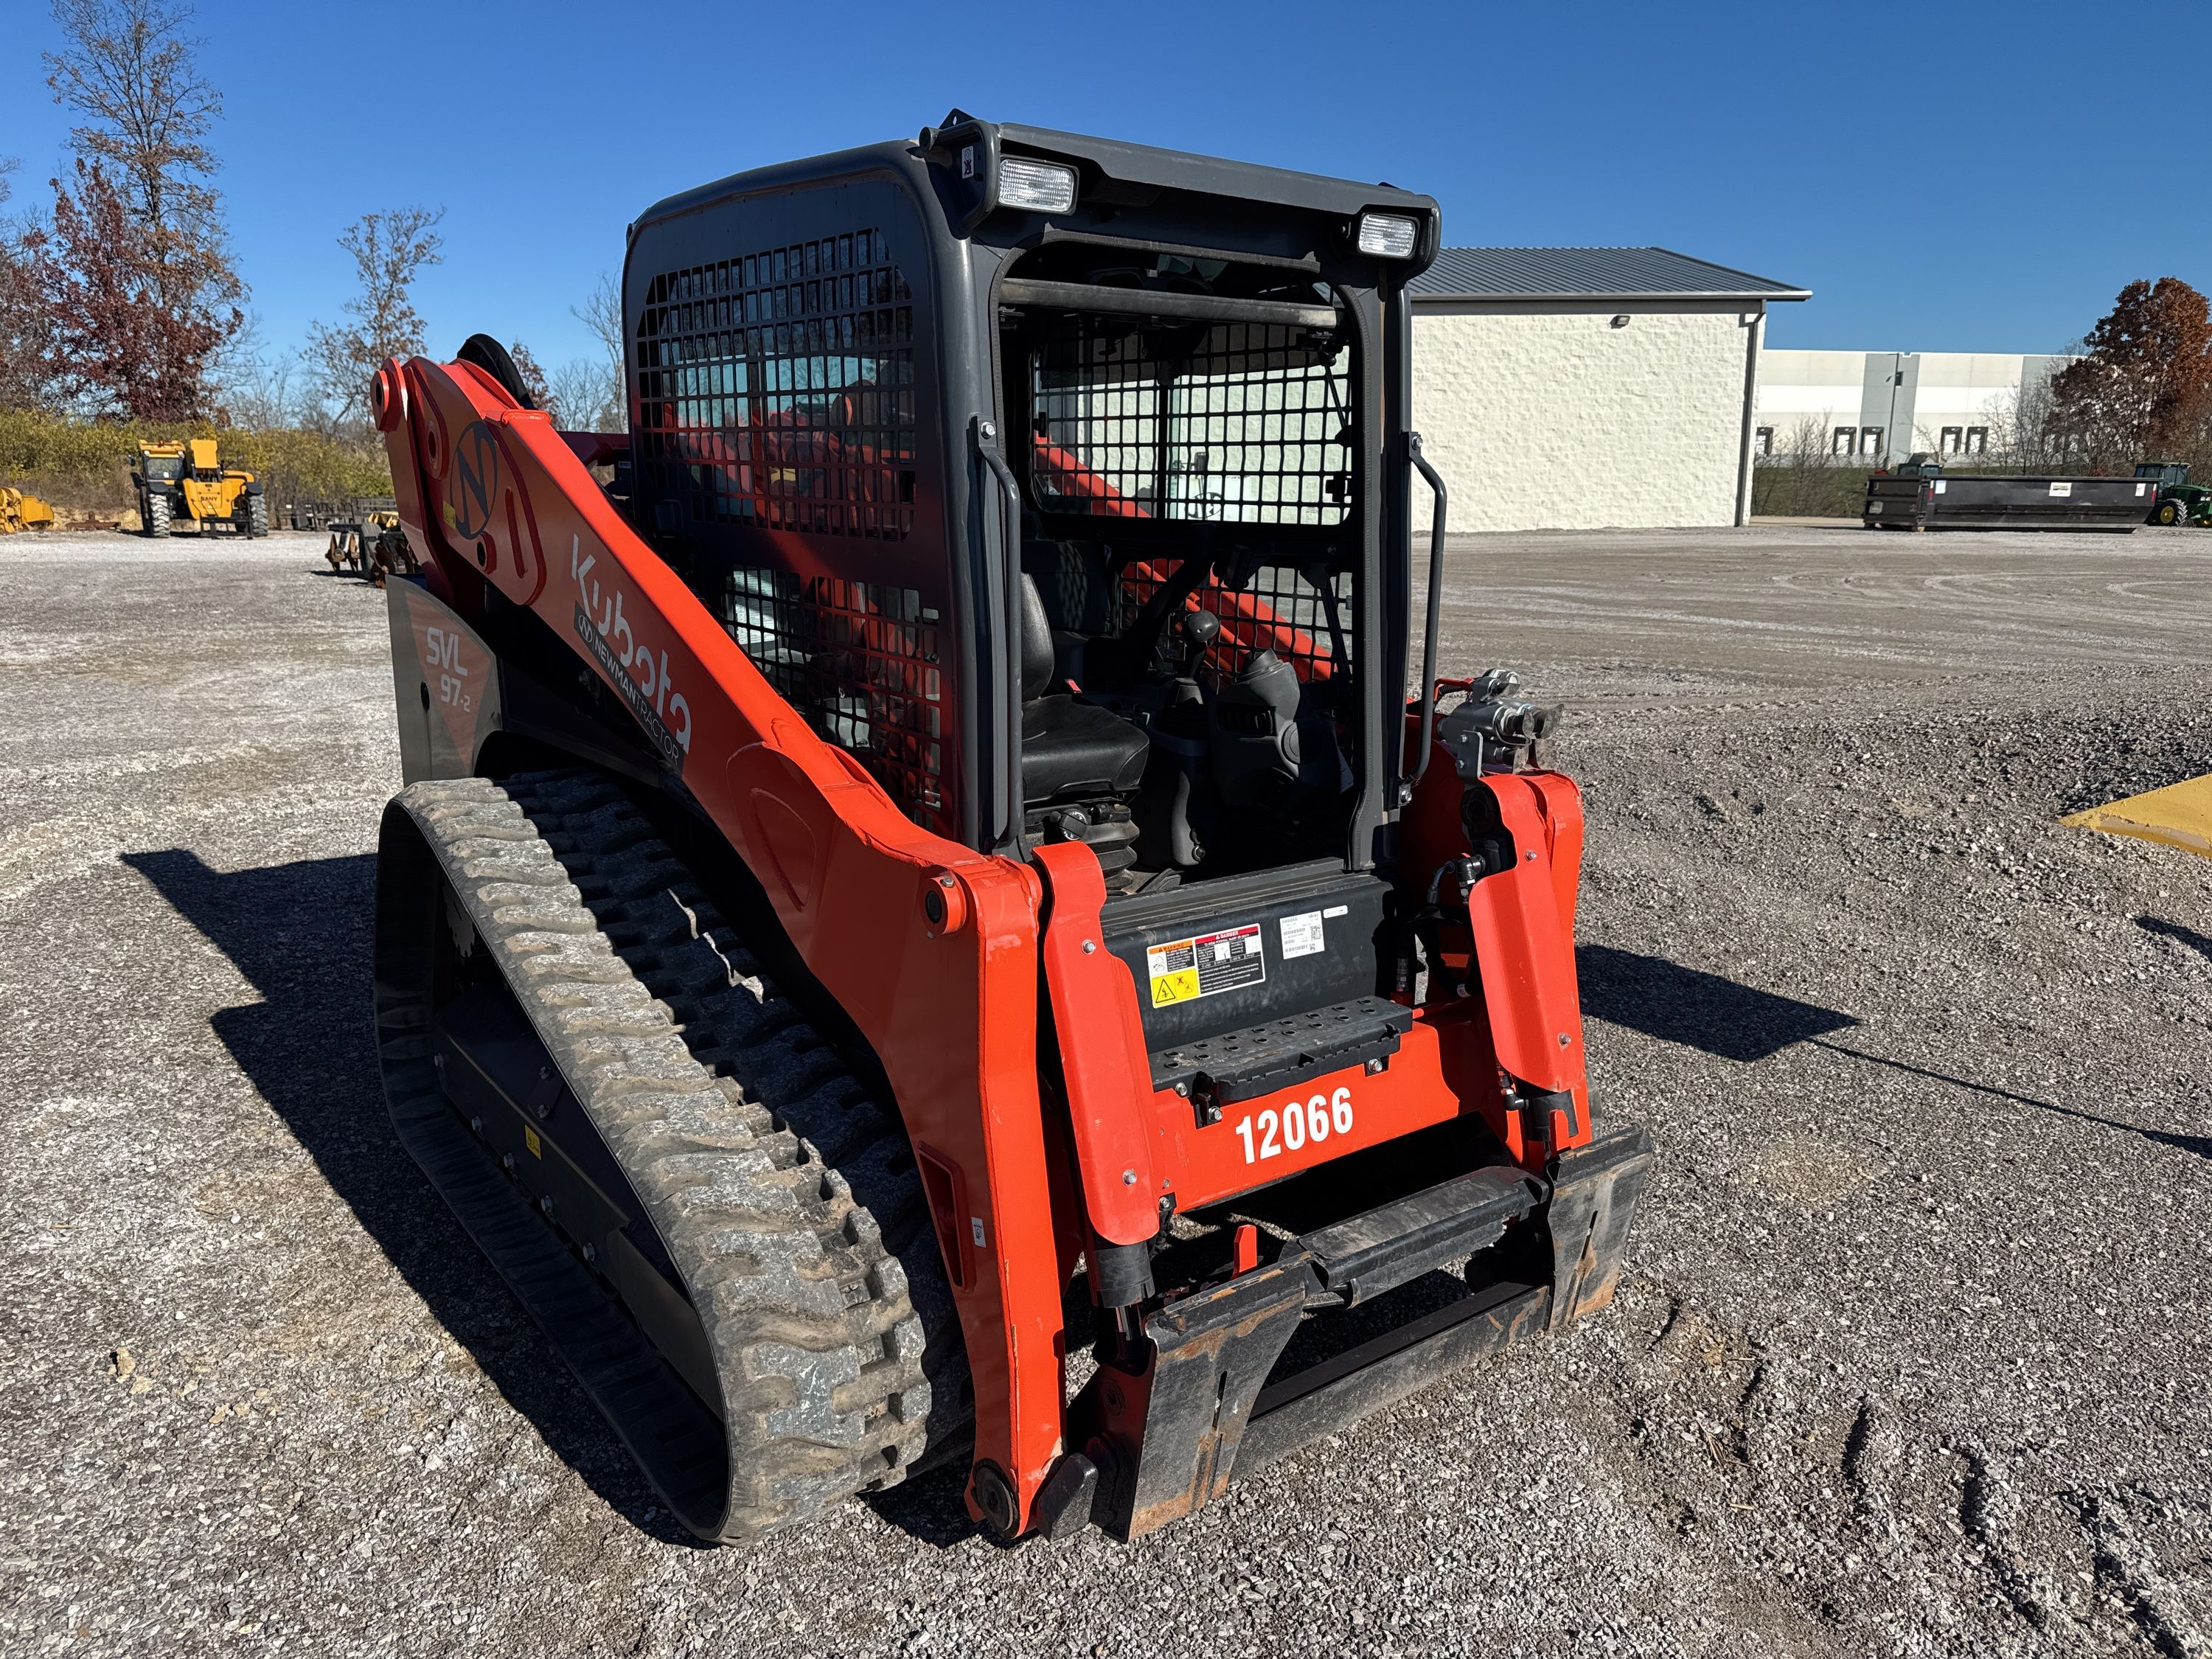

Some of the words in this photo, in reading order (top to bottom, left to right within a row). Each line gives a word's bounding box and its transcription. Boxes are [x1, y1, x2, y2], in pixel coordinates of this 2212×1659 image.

[426, 626, 467, 677] SVL
[571, 533, 692, 754] Kubota
[1163, 943, 1184, 952] WARNING
[1220, 931, 1239, 939] DANGER
[1235, 1087, 1354, 1165] 12066
